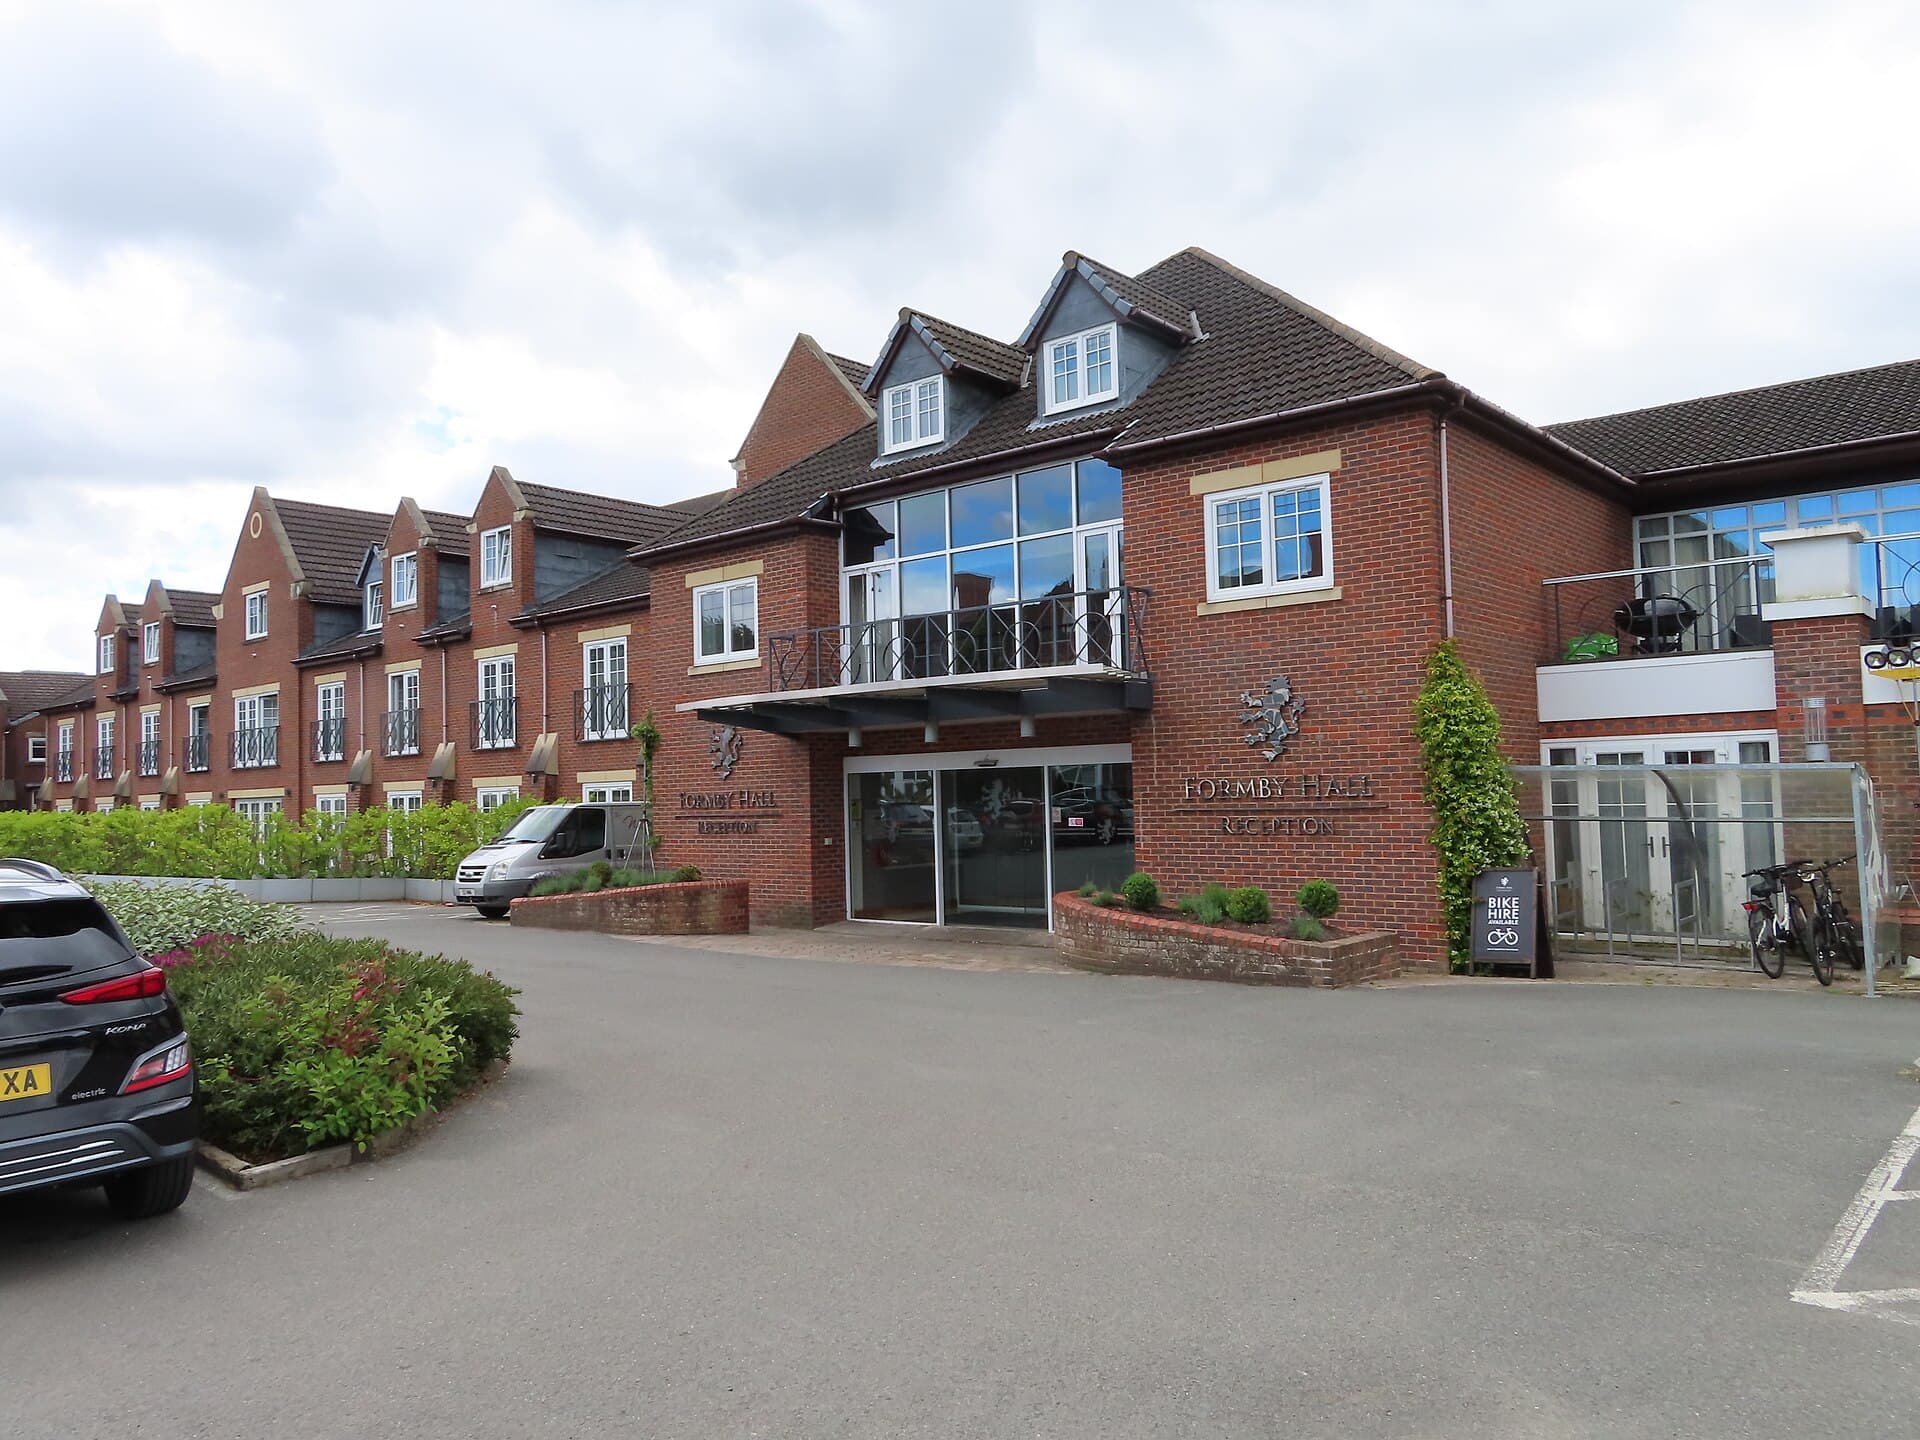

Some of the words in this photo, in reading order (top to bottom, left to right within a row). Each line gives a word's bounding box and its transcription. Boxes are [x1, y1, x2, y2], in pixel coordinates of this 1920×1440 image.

[1184, 777, 1288, 800] FORMBY
[1300, 775, 1376, 797] HALL
[740, 790, 776, 807] HALL
[1222, 817, 1335, 835] RECEPTION
[1488, 897, 1519, 908] BIKE
[1488, 909, 1519, 919] HIRE
[105, 1023, 146, 1035] KONA
[71, 1087, 106, 1100] electric
